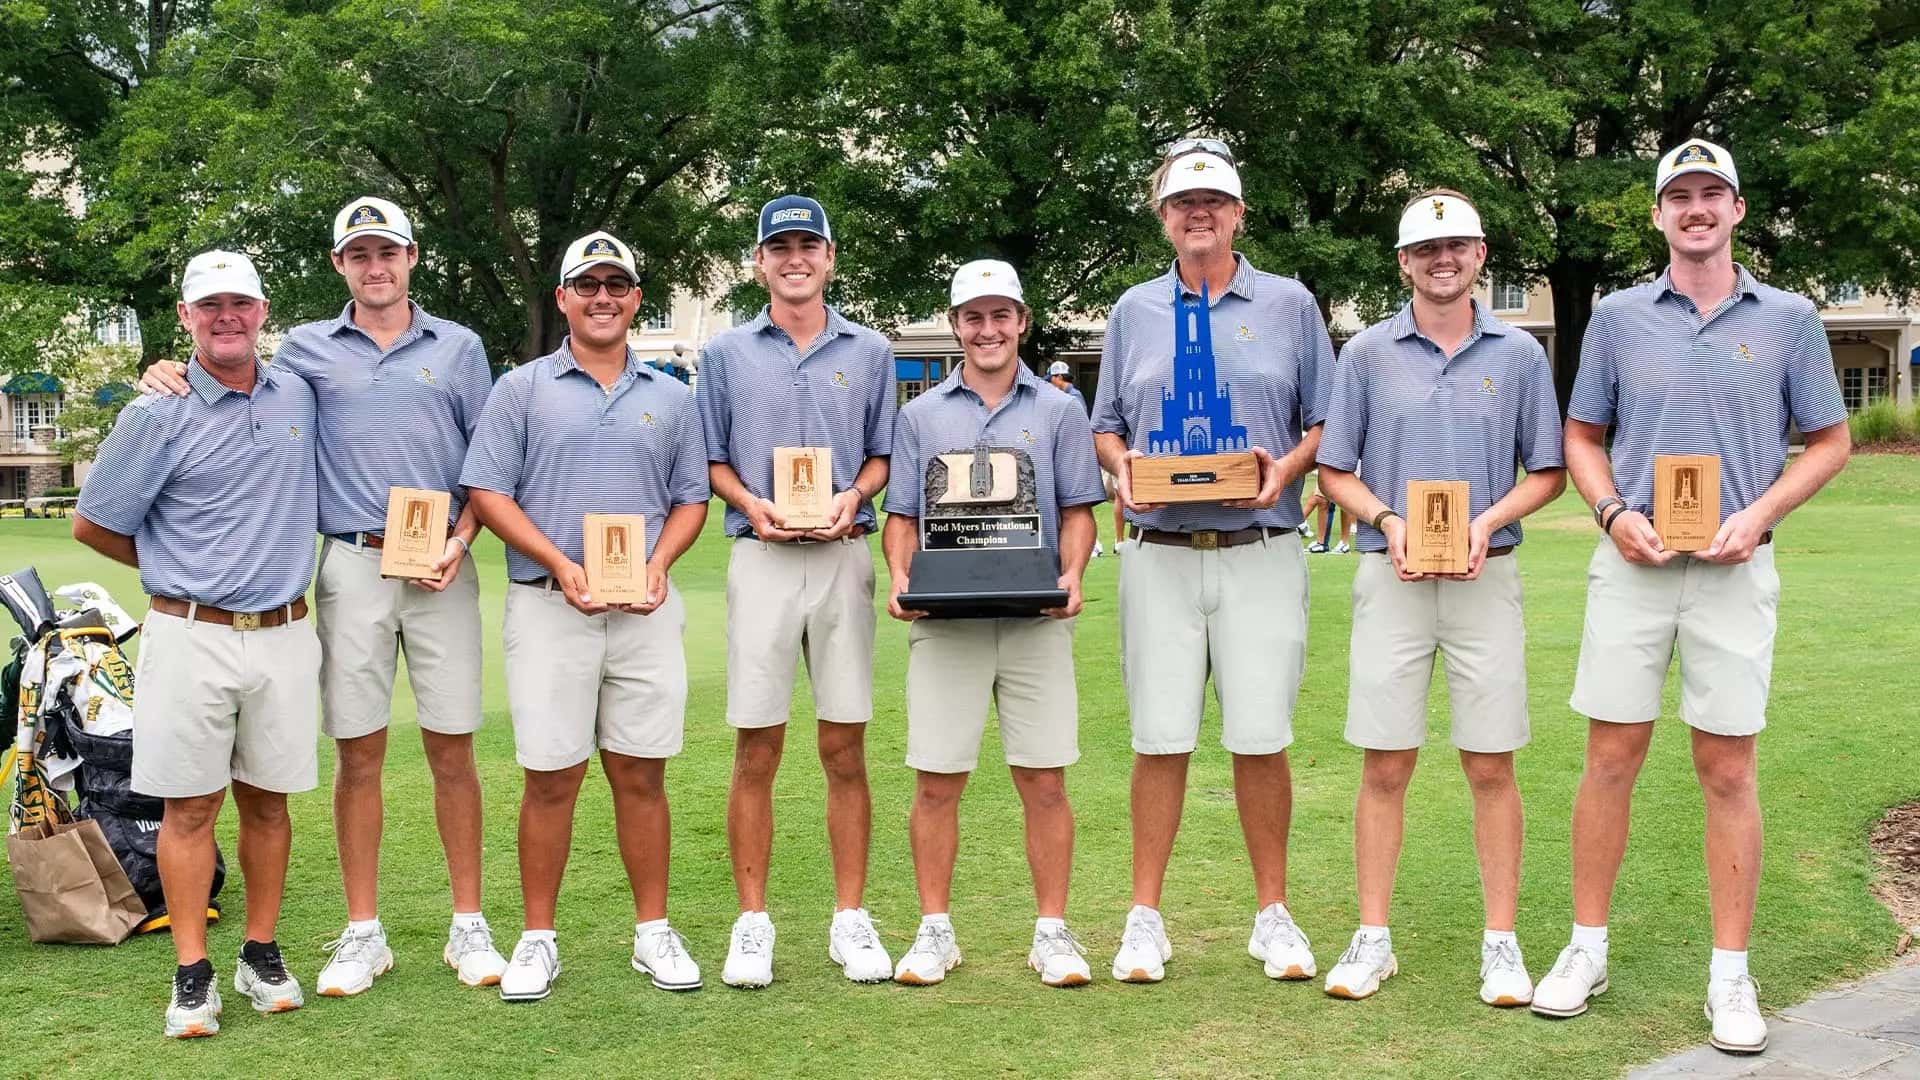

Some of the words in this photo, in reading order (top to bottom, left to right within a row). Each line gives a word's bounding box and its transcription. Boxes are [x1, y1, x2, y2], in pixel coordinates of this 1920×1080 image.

[930, 523, 949, 532] Rod
[951, 522, 980, 533] Myers
[981, 521, 1033, 532] Invitational
[956, 535, 1008, 546] Champions
[18, 752, 45, 832] MASO
